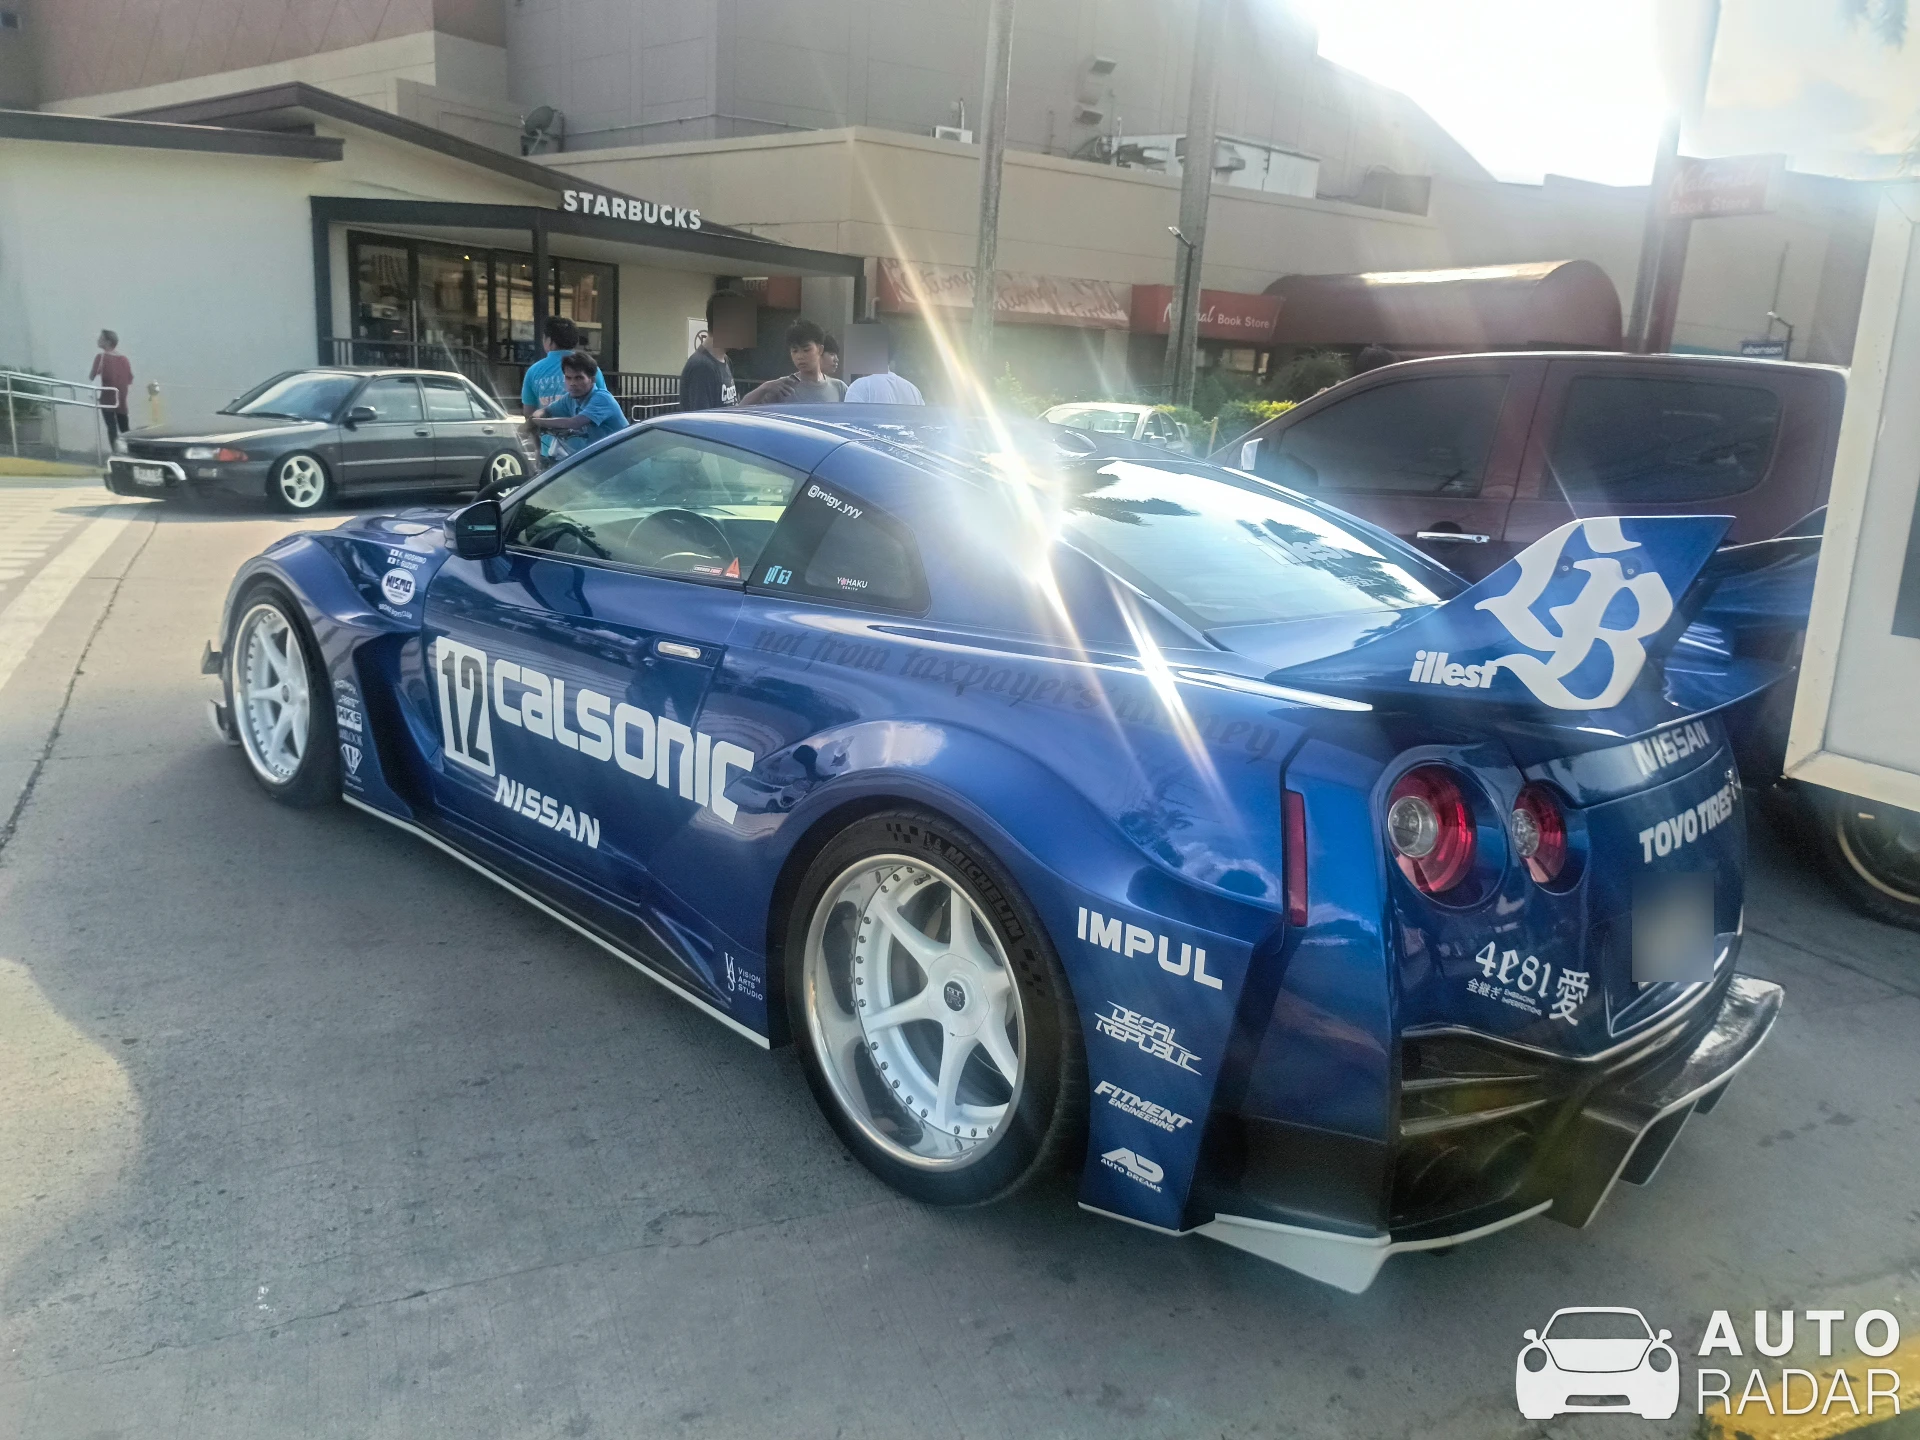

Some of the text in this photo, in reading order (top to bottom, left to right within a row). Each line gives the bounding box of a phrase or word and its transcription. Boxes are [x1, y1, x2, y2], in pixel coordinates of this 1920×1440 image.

[563, 190, 702, 230] STARBUCKS
[1218, 313, 1241, 326] Book
[1245, 316, 1270, 329] Store
[808, 485, 863, 519] @migy_yyy
[385, 574, 413, 593] NISMO
[753, 628, 808, 657] not
[803, 631, 891, 672] from
[1408, 649, 1498, 689] illest
[337, 708, 363, 727] HKS
[441, 649, 492, 770] 12
[1632, 720, 1711, 777] NISSAN
[494, 774, 600, 849] NISSAN
[1639, 808, 1698, 864] TOYO
[944, 845, 1025, 943] MICHELIN
[1077, 906, 1223, 991] IMPUL
[738, 966, 761, 984] VISION
[738, 975, 756, 989] ARTS
[738, 983, 763, 1001] STUDIO
[1548, 967, 1590, 1027] 愛
[1094, 1012, 1203, 1077] REPUBLIC
[1107, 1000, 1191, 1054] DECAL
[1094, 1080, 1194, 1129] FITMENT
[1108, 1097, 1176, 1134] ENGINEERING
[1100, 1158, 1163, 1194] AUTO DREAMS
